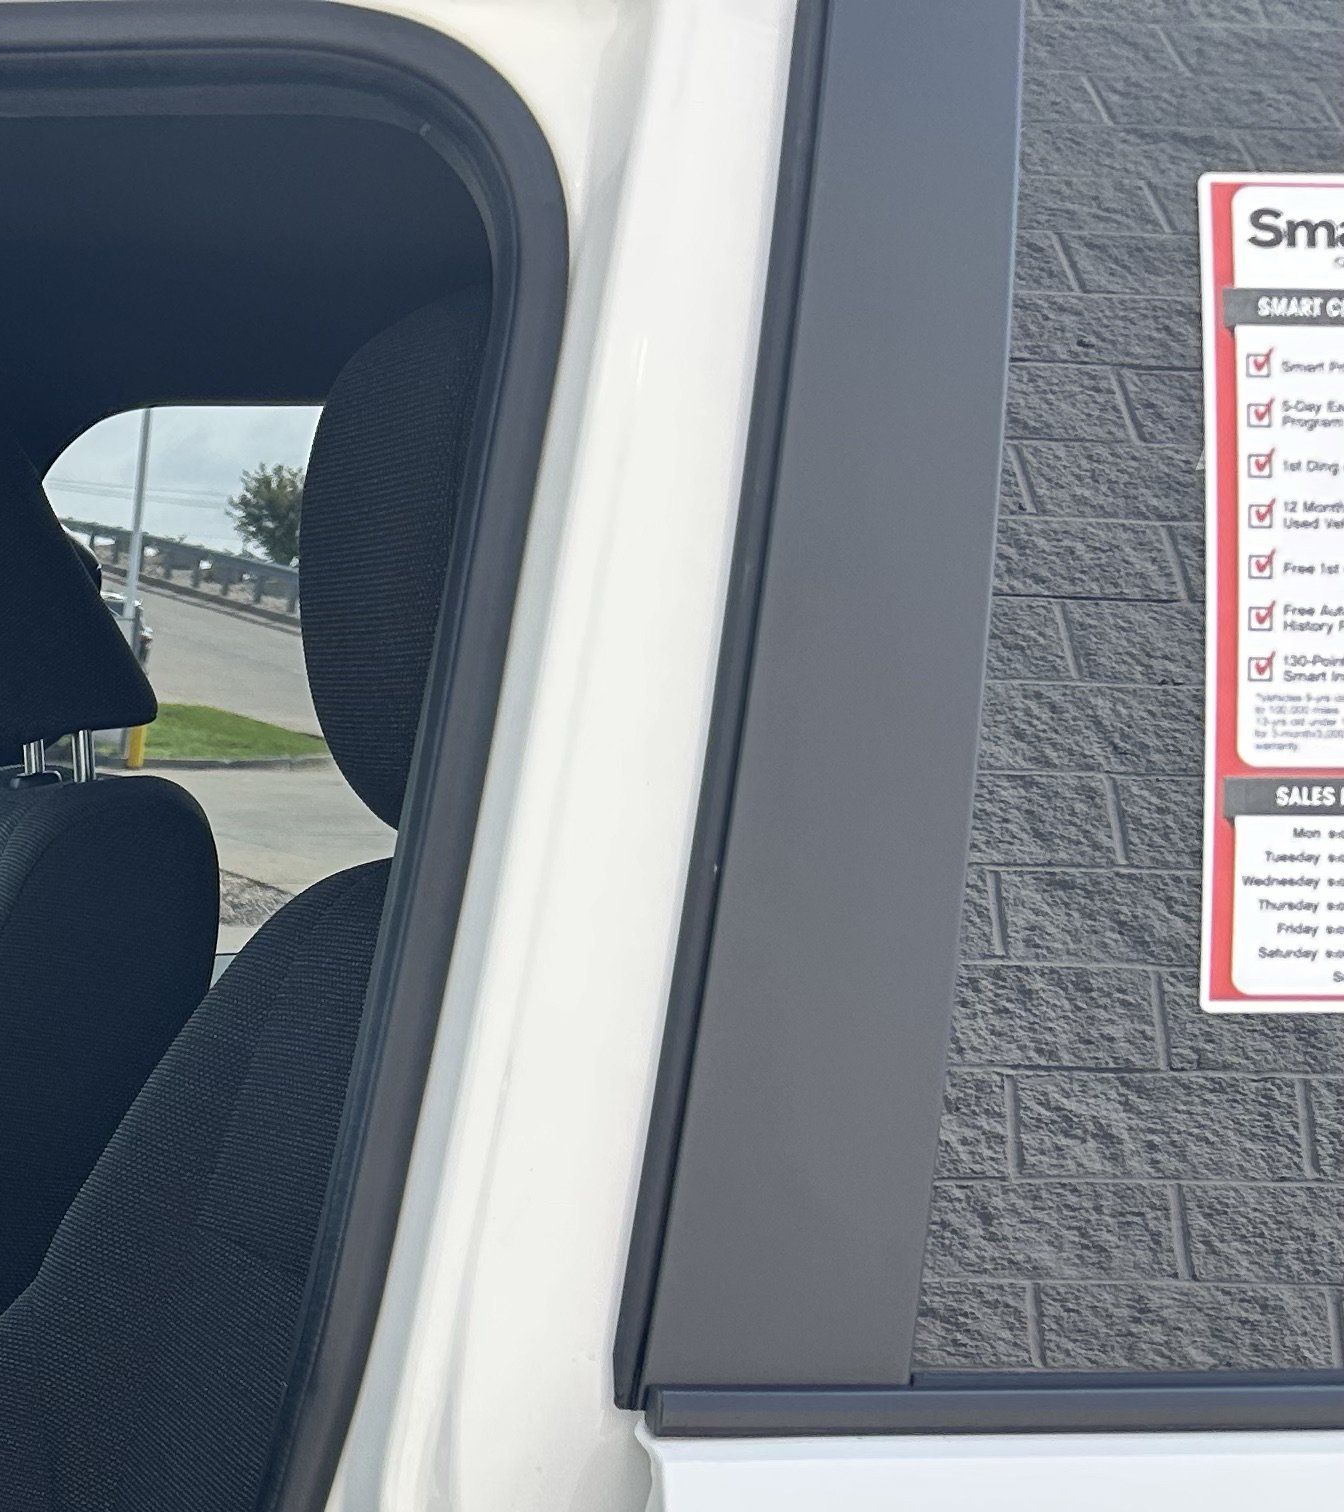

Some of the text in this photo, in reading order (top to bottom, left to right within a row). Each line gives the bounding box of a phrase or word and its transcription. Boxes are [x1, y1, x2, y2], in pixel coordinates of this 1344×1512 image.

[1248, 206, 1344, 249] Sm
[1256, 295, 1323, 318] SMART
[1281, 360, 1324, 373] Smart
[1283, 516, 1320, 530] Used
[1283, 561, 1316, 576] Free
[1283, 604, 1316, 618] Free
[1283, 619, 1334, 636] History
[1283, 669, 1328, 682] Smart
[1275, 785, 1336, 807] SALES
[1292, 826, 1322, 839] Mon
[1264, 850, 1321, 866] Tuesday
[1242, 874, 1321, 890] Wednesday
[1258, 898, 1320, 914] Thursday
[1276, 922, 1319, 937] Friday
[1258, 946, 1319, 962] Saturday
